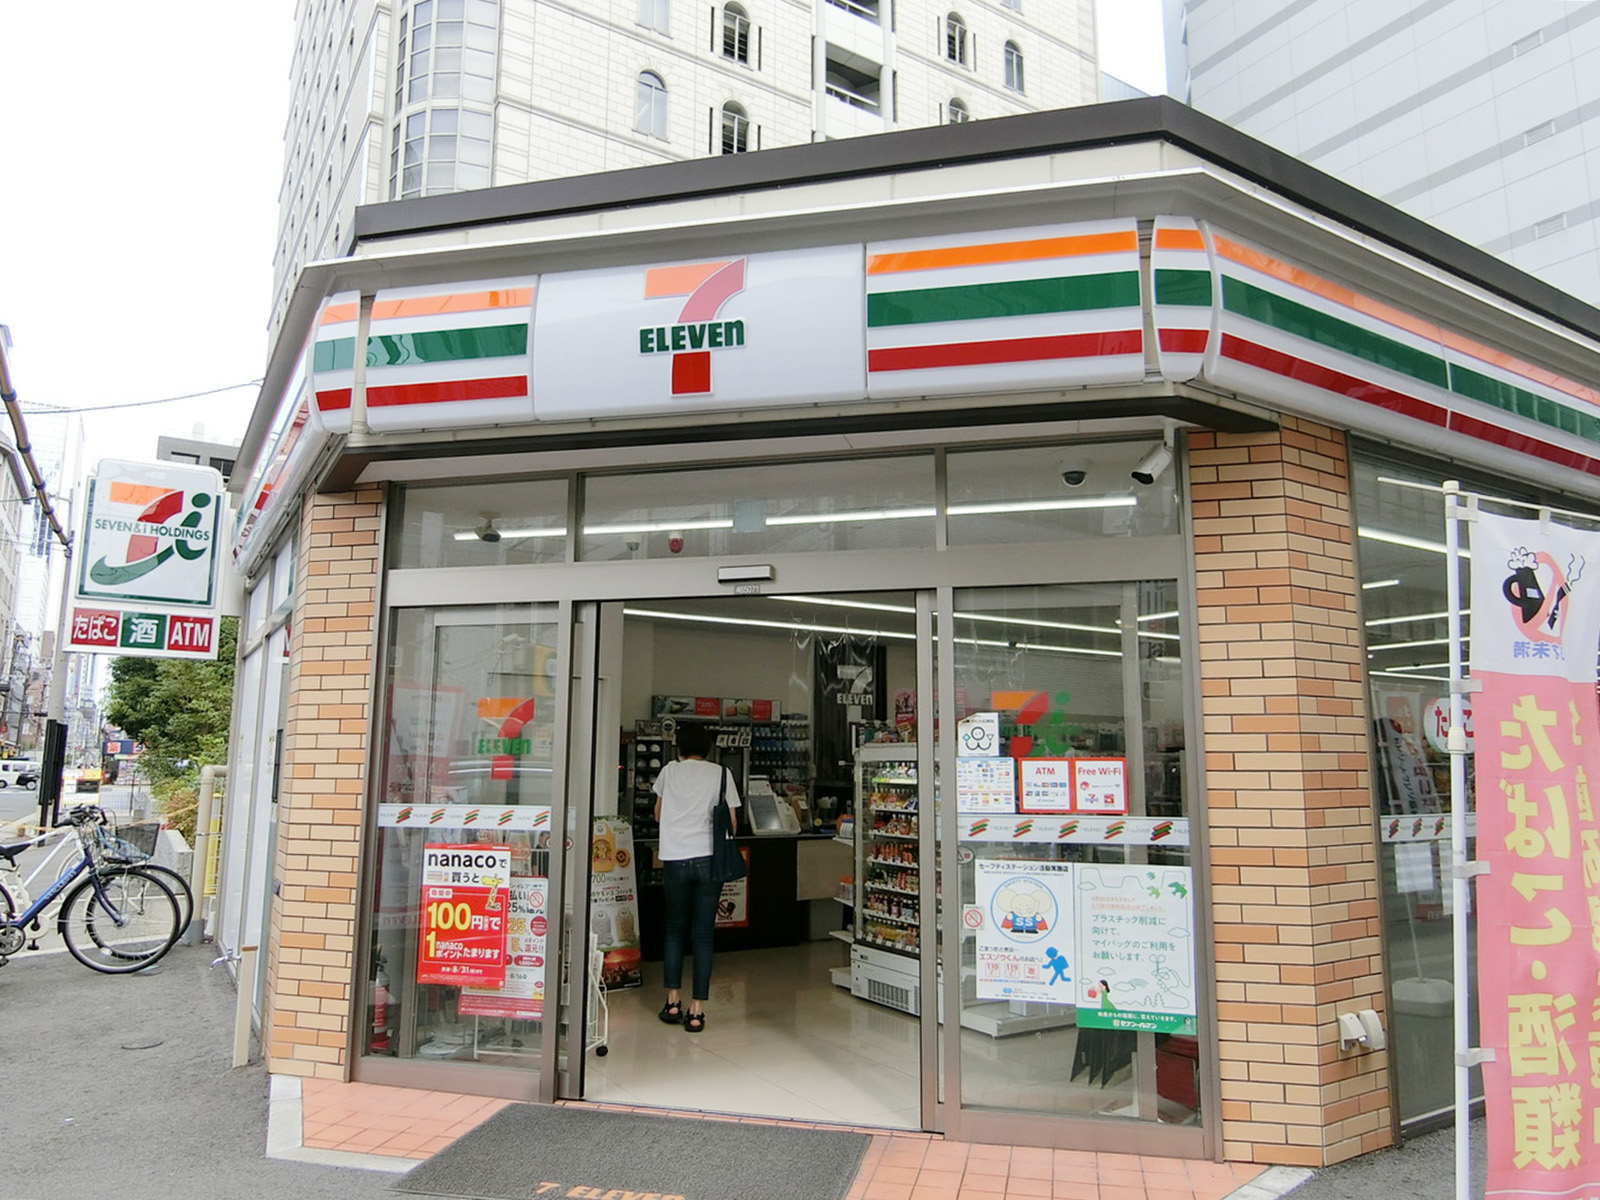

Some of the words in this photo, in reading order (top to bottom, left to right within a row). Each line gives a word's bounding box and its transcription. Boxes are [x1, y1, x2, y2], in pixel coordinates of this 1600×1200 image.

[150, 525, 210, 541] HOLDINGS
[74, 615, 118, 641] たばこ
[129, 618, 157, 644] 酒
[170, 621, 209, 647] ATM
[1035, 767, 1055, 775] ATM
[1077, 767, 1097, 776] Free
[1099, 767, 1121, 775] Wi-Fi
[452, 871, 480, 884] 買うと
[1015, 917, 1033, 927] SS
[1091, 914, 1167, 926] プラスチック削減に
[1091, 926, 1120, 935] 向けて、
[436, 941, 464, 950] nanaco
[1092, 939, 1176, 951] マイバッグのご利用を
[1092, 950, 1145, 962] お願いします。
